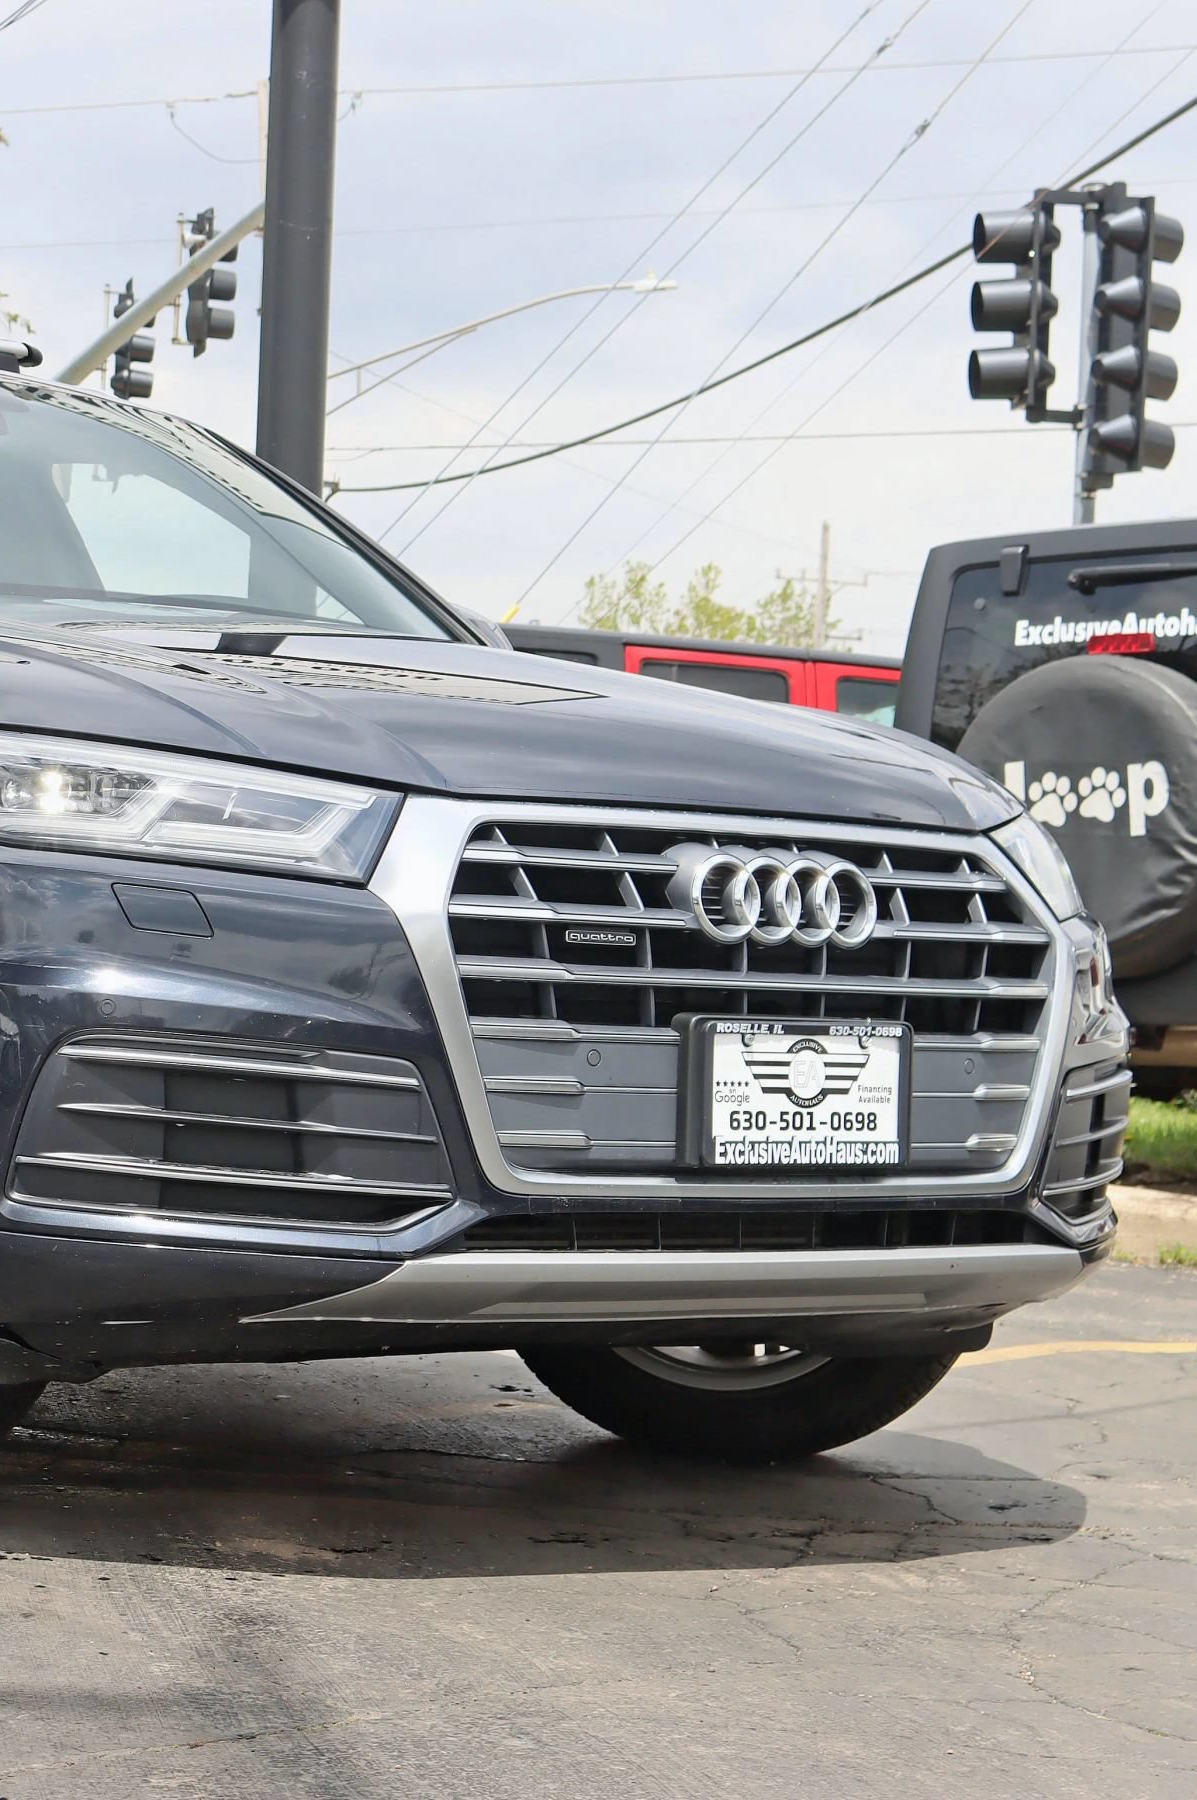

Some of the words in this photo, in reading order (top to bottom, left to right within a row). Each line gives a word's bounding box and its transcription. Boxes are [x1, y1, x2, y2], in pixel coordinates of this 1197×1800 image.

[1014, 607, 1197, 646] ExclusiveAutoh
[570, 932, 634, 943] quattro
[716, 1022, 770, 1035] ROSELLE,
[773, 1023, 785, 1035] IL
[829, 1025, 903, 1037] 630-501-0698
[857, 1084, 892, 1096] Financing
[714, 1090, 750, 1106] Google
[858, 1096, 891, 1105] Available
[729, 1110, 878, 1131] 630-501-0698
[715, 1136, 899, 1165] ExclusiveAutoHaus.com
